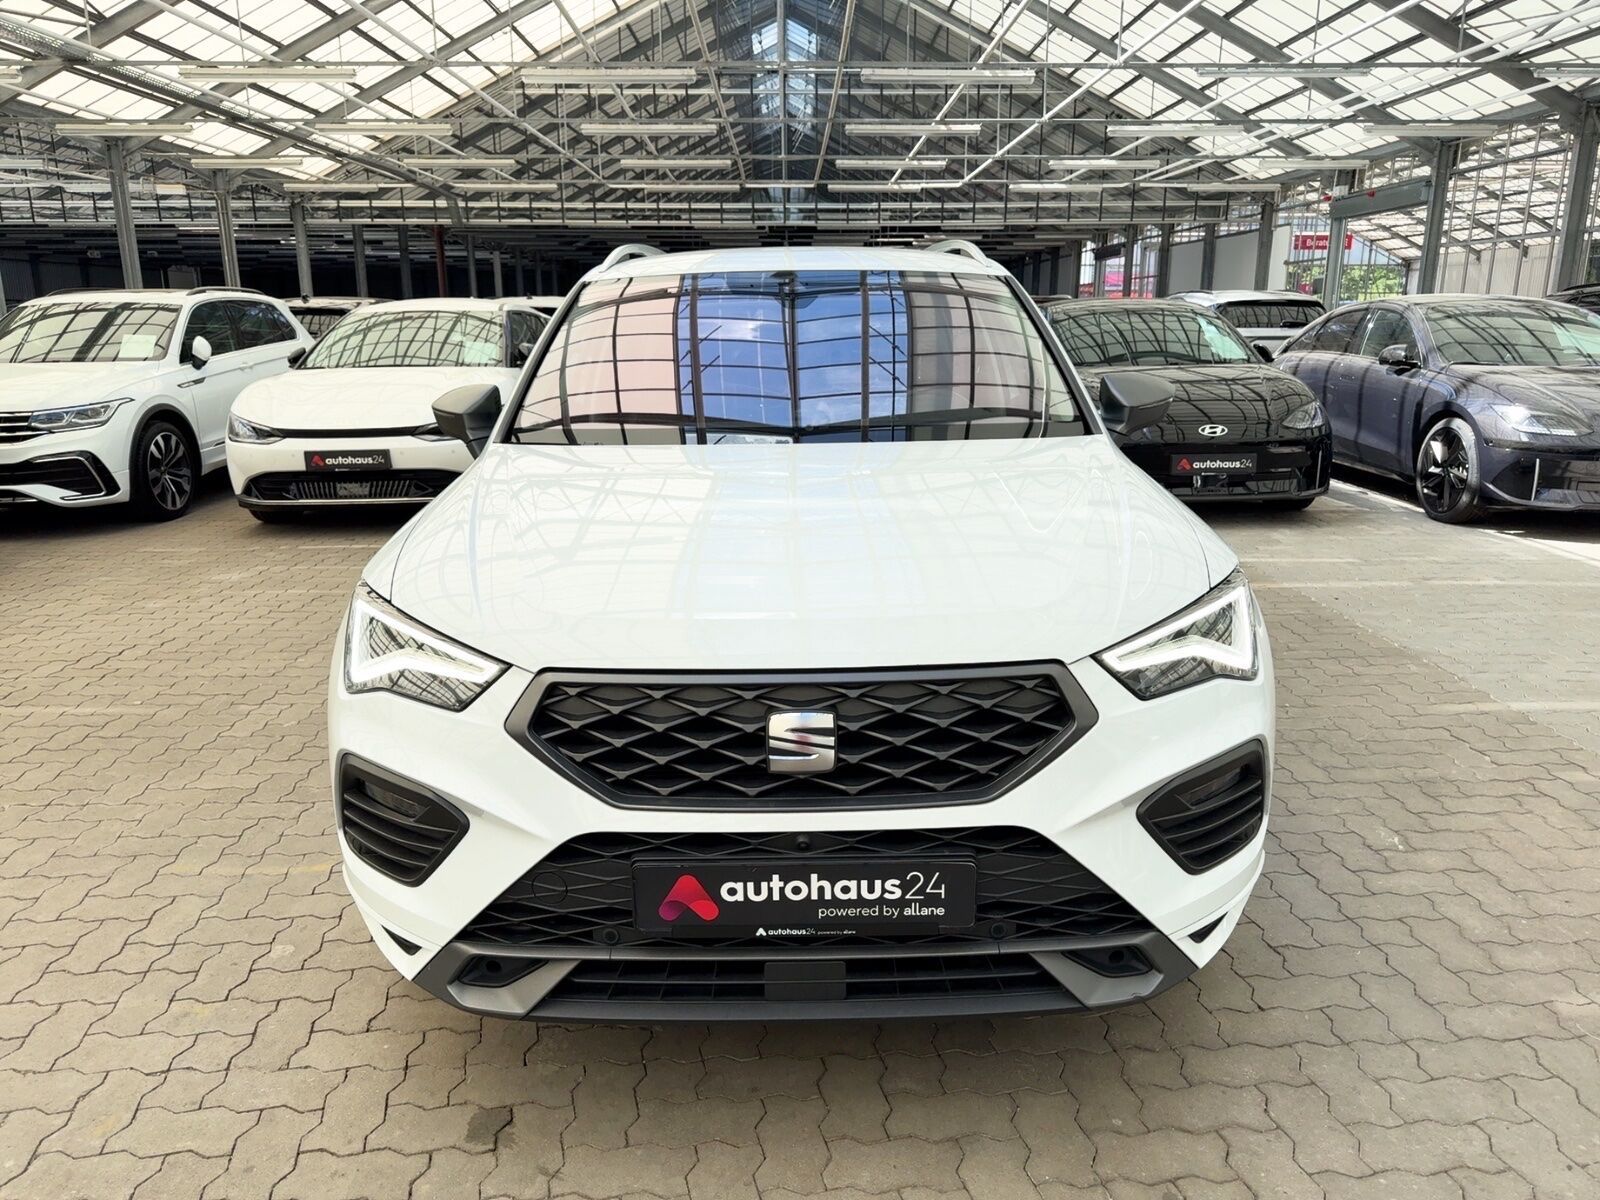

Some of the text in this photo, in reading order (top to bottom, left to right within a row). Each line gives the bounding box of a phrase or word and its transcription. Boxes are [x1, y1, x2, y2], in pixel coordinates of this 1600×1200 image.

[325, 455, 385, 465] autohaus24
[1193, 459, 1253, 468] autohaus24
[720, 871, 946, 902] autohaus24
[818, 903, 945, 919] powered by allane
